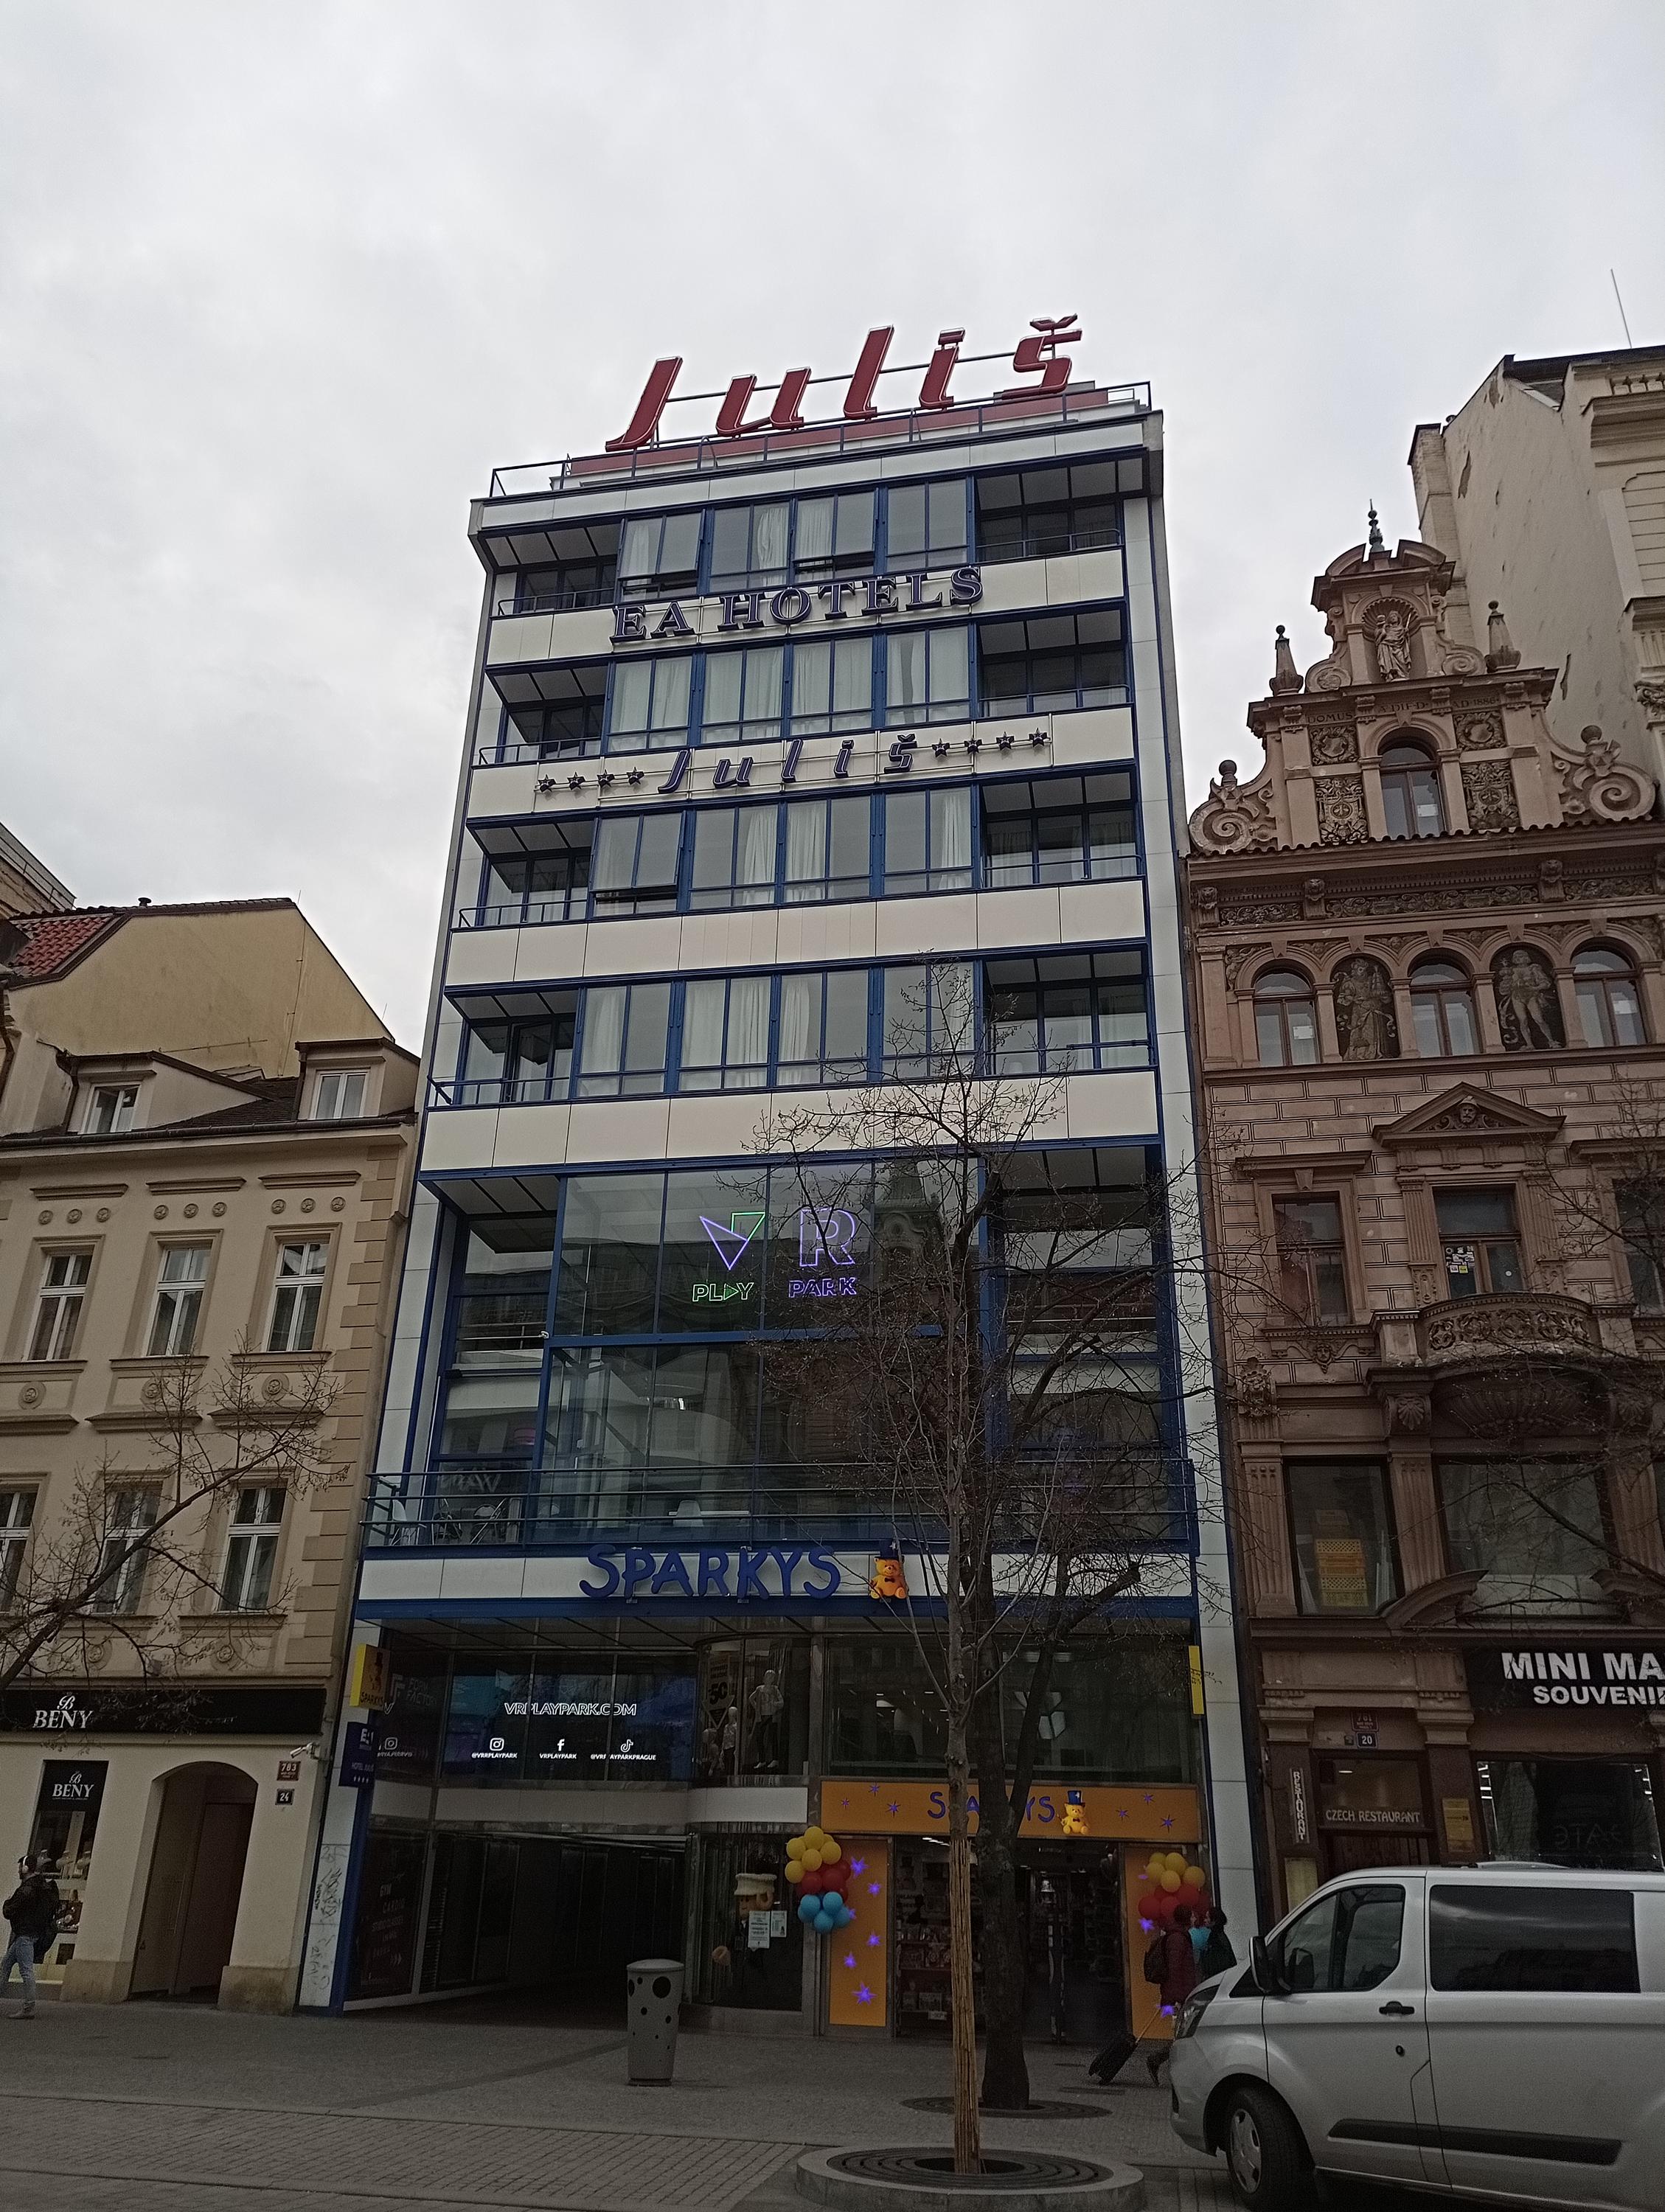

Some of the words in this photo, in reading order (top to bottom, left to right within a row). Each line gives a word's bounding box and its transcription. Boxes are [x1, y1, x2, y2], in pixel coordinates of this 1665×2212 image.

[605, 313, 1082, 452] Juliš
[610, 602, 695, 643] EA
[717, 566, 983, 632] HOTELS
[658, 734, 917, 793] Juliš
[692, 1281, 754, 1302] PLAY
[788, 1277, 857, 1298] PARK
[580, 1544, 840, 1599] SPARKYS
[1501, 1652, 1591, 1680] MINI
[32, 1710, 94, 1728] BENY
[1361, 1735, 1373, 1745] 20
[539, 1752, 577, 1760] VRPLAYPARK
[52, 1784, 94, 1797] BENY
[280, 1792, 291, 1801] 24
[1325, 1809, 1355, 1822] CZECH
[1358, 1811, 1420, 1823] RESTAURANT
